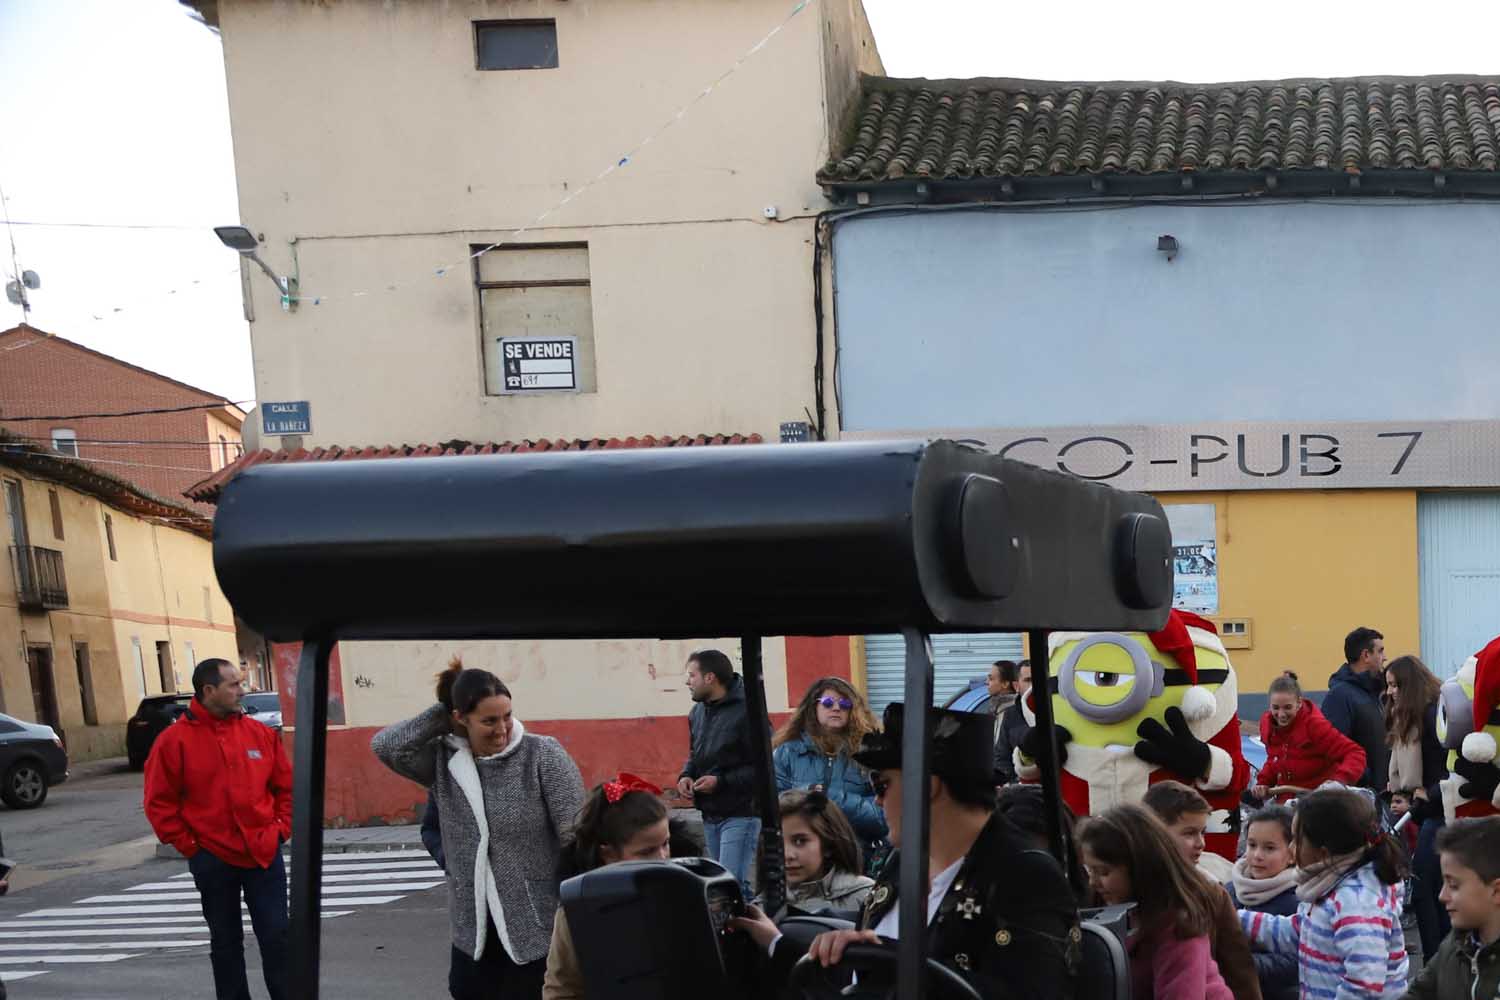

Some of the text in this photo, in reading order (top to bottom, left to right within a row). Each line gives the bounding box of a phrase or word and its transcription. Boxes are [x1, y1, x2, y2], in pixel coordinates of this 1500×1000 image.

[505, 343, 571, 358] SE VENDE
[1377, 431, 1423, 475] 7
